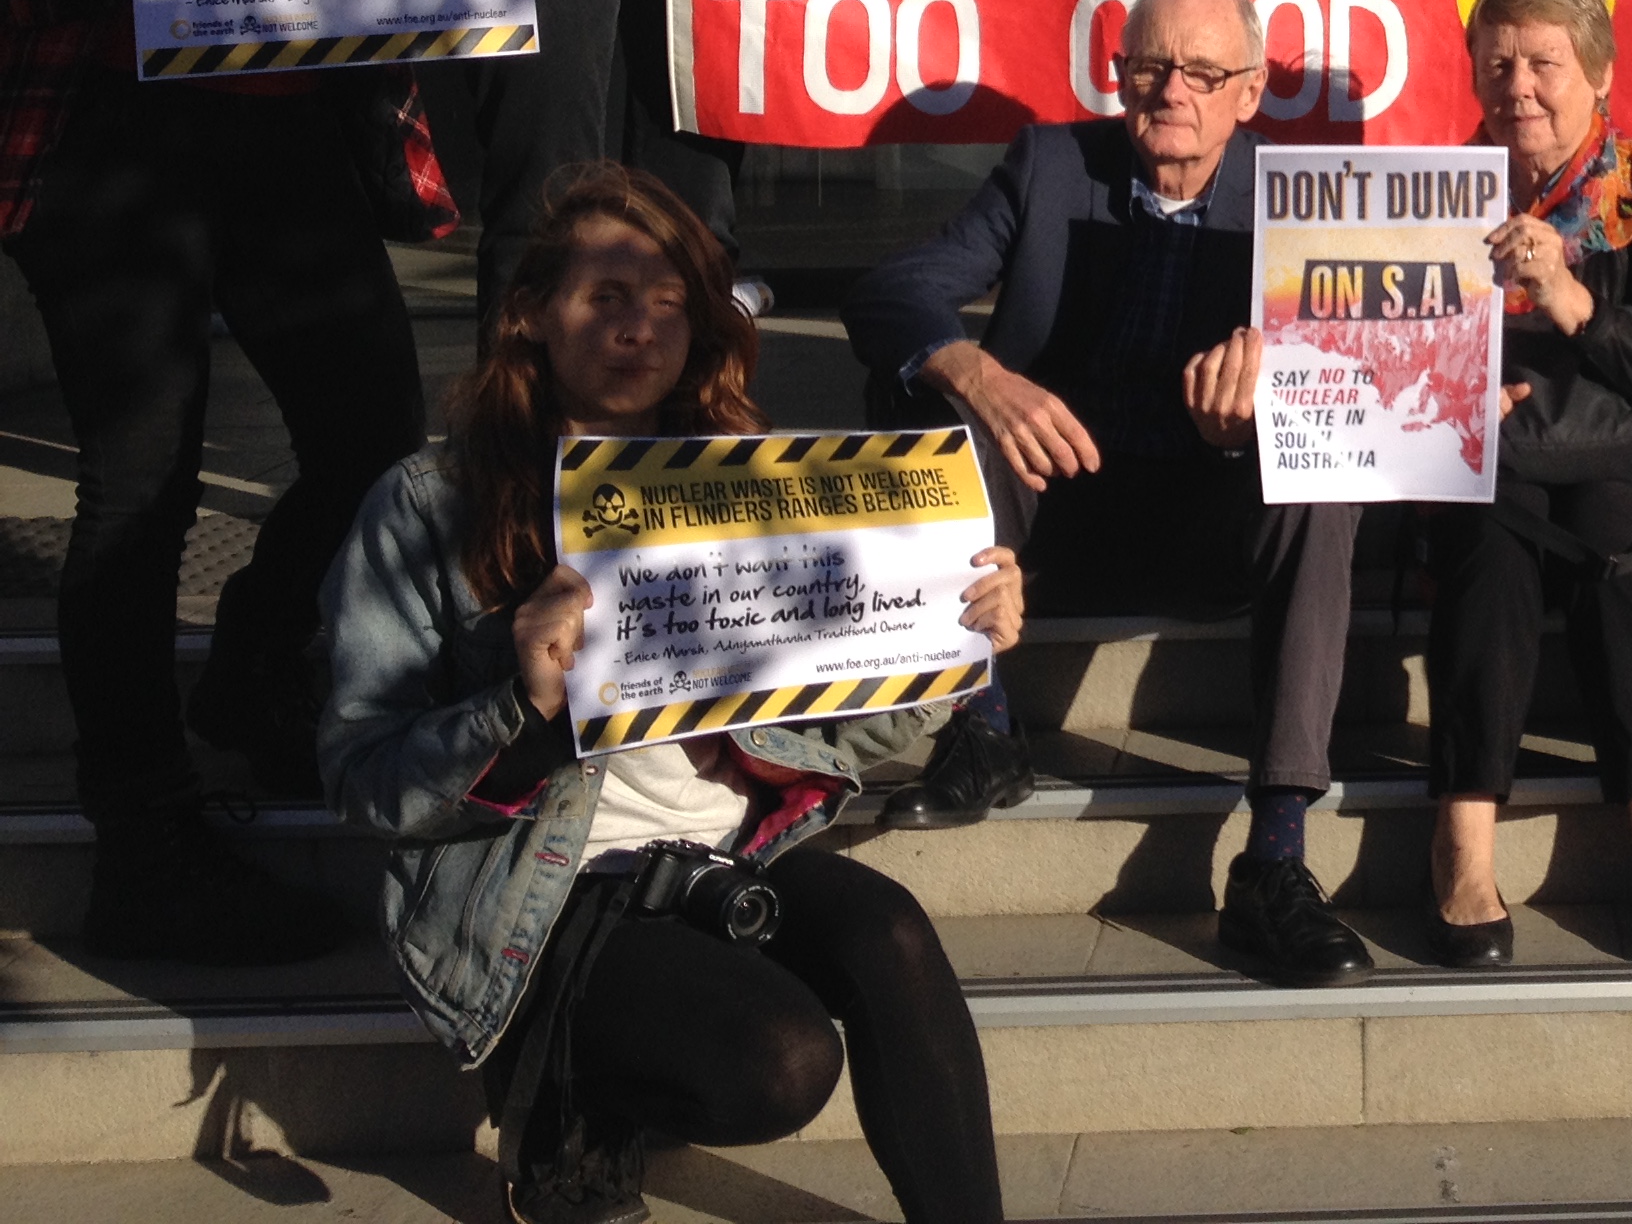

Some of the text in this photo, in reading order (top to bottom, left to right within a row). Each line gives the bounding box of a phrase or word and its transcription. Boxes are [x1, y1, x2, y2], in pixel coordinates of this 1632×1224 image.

[279, 20, 319, 33] WELCOME
[1266, 161, 1500, 221] DON'T DUMP
[1309, 265, 1457, 319] ON S.A.
[1271, 368, 1375, 388] SAY NO TO
[1345, 408, 1365, 426] IN
[1274, 430, 1332, 449] SOU
[640, 468, 948, 506] NUCLEAR WASTE IS NOT WELCOME
[643, 486, 960, 531] IN FLINDERS RANGES BECAUSE:
[618, 555, 659, 587] We
[735, 546, 792, 576] want
[799, 544, 845, 569] this
[619, 570, 866, 613] waste in our country,
[617, 589, 927, 641] it's too toxic and long lived.
[815, 623, 876, 641] Traditional
[880, 621, 915, 633] Owner
[816, 649, 962, 673] www.foe.org.au/anti-nuclear
[620, 676, 663, 692] friends of
[692, 671, 753, 690] NOT WELCOME
[621, 687, 663, 700] the earth
